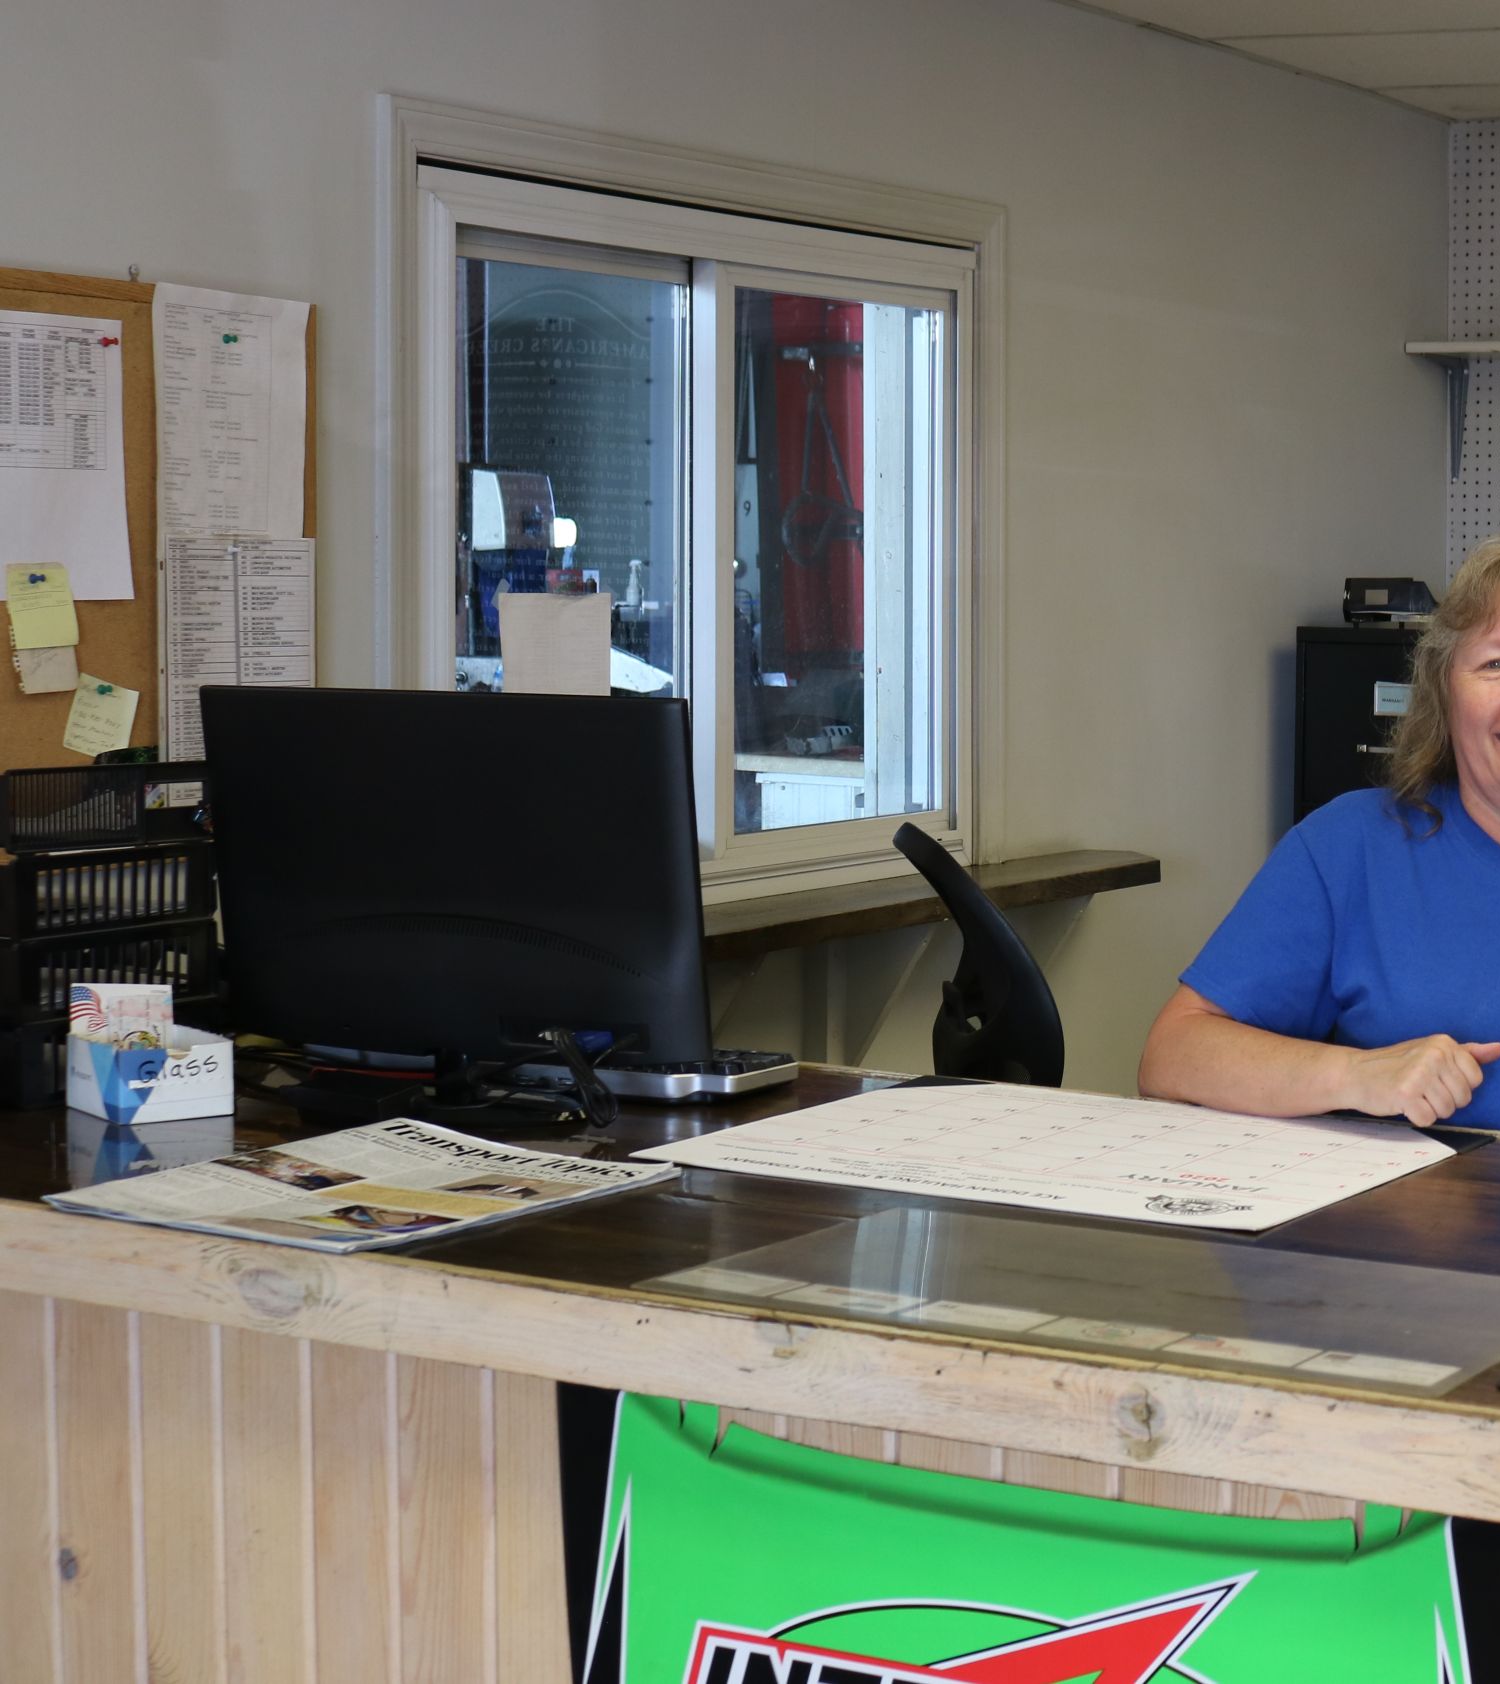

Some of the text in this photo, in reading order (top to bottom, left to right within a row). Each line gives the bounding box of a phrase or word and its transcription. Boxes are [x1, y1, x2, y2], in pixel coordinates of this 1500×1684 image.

[137, 1055, 219, 1083] Glass
[382, 1122, 541, 1167] Transport
[540, 1157, 645, 1179] Topics
[1116, 1173, 1269, 1192] JANUARY
[1179, 1172, 1231, 1182] 2020
